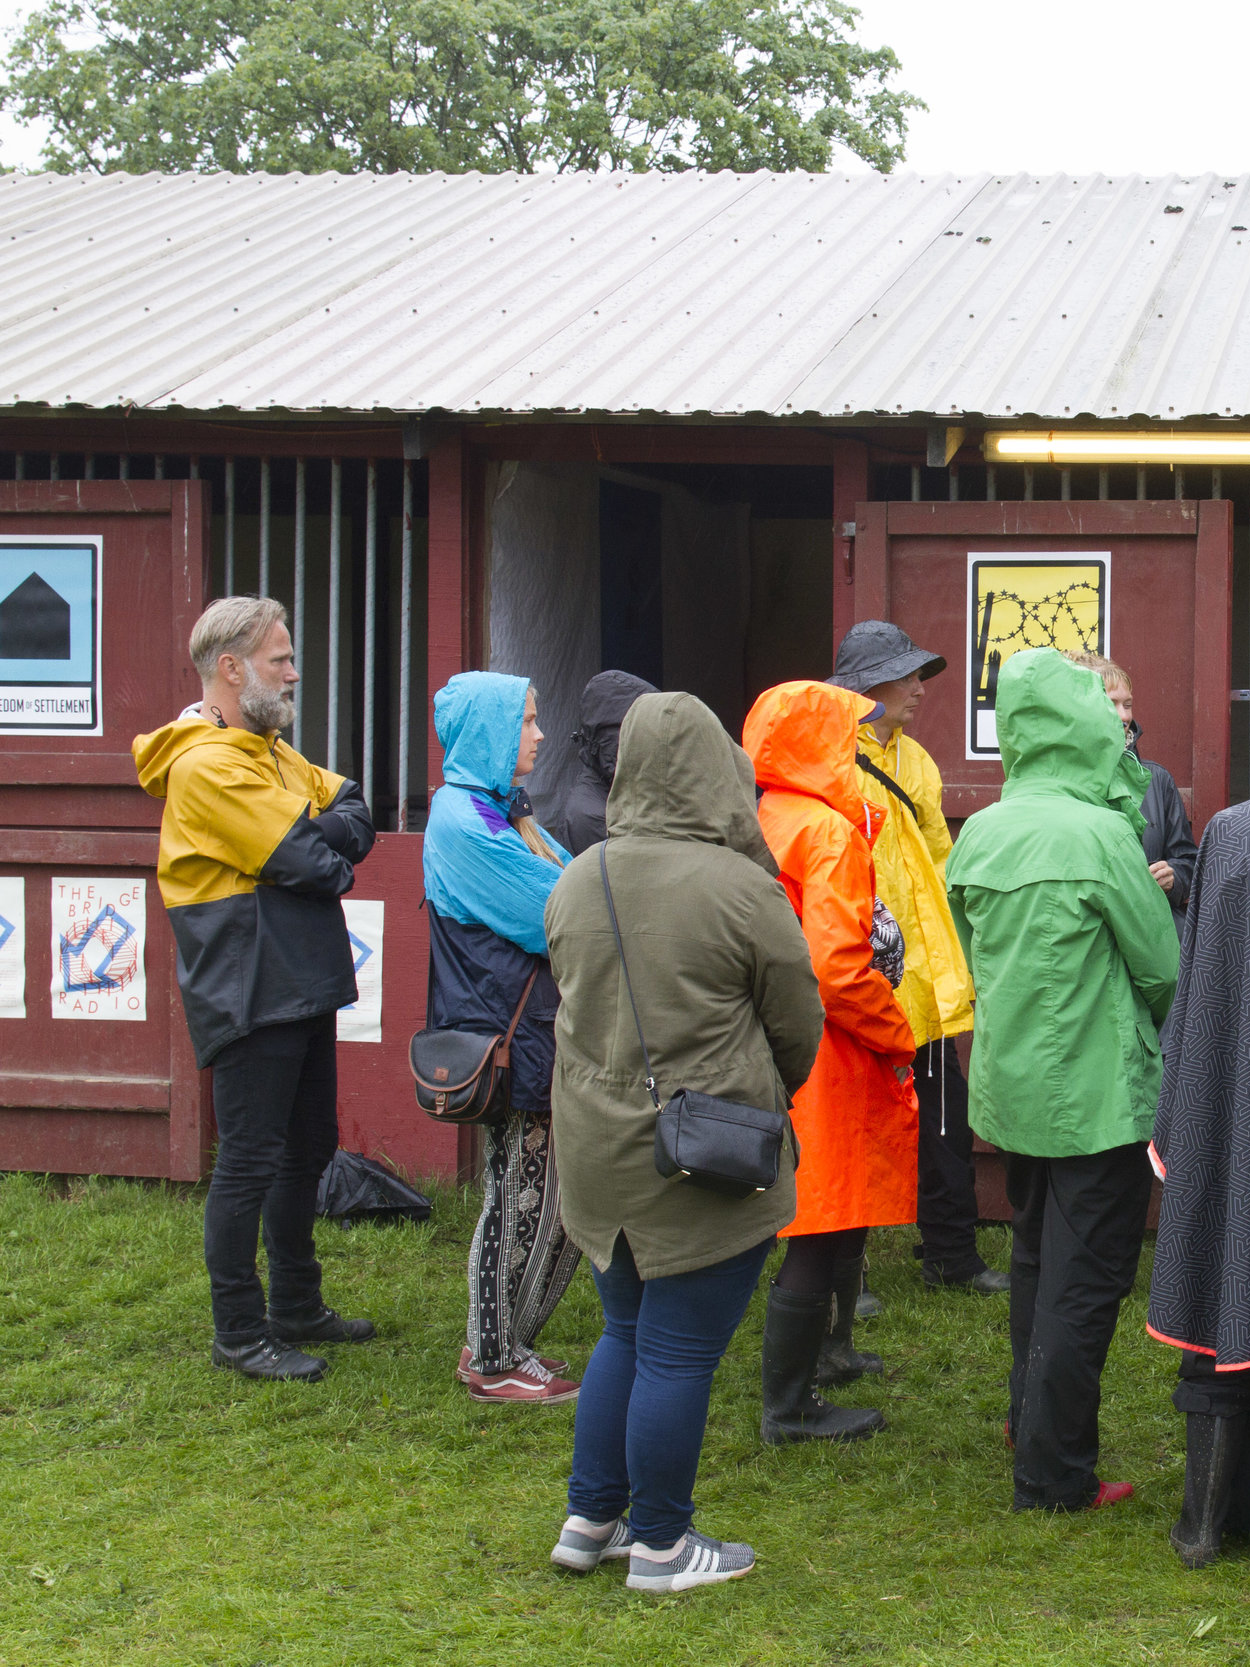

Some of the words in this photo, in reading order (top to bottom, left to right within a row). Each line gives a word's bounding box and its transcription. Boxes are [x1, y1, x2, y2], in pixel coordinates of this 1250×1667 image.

[26, 701, 33, 710] OF
[34, 699, 90, 713] SETTLEMENT
[58, 884, 96, 901] THE
[68, 885, 140, 918] BRIDGE
[59, 991, 140, 1014] RADIO
